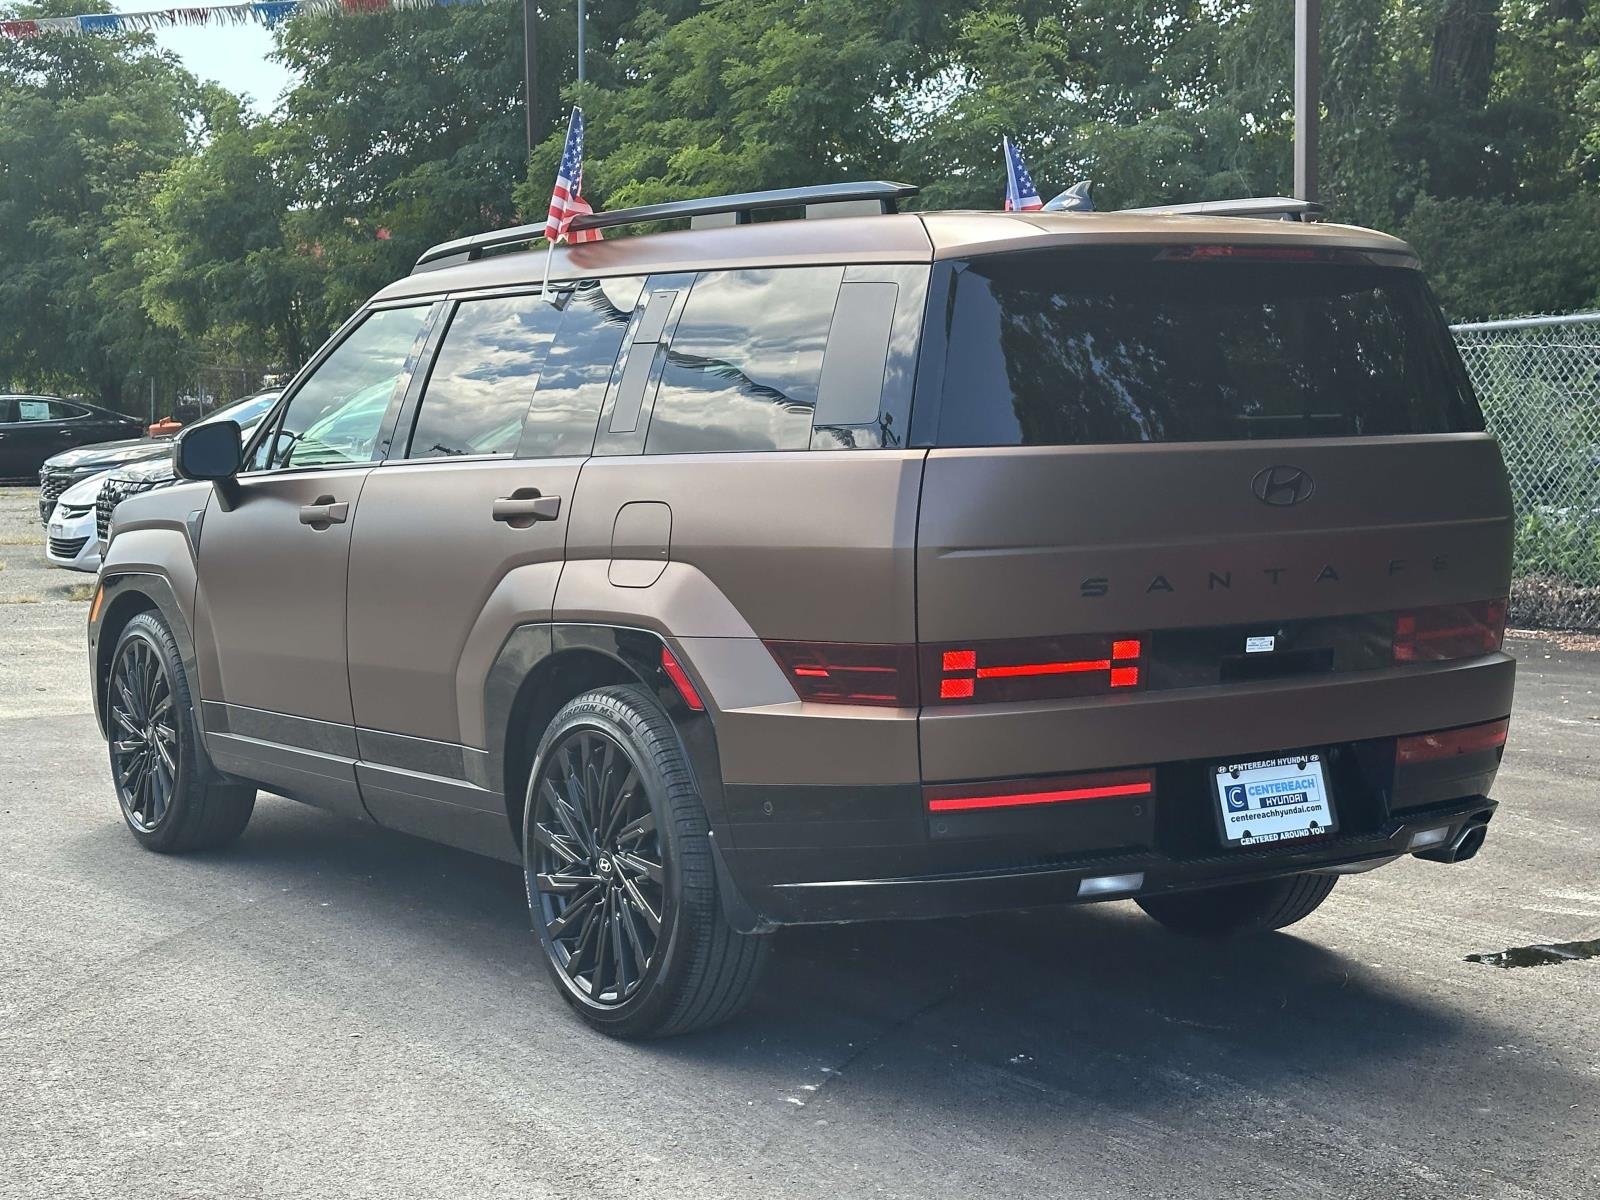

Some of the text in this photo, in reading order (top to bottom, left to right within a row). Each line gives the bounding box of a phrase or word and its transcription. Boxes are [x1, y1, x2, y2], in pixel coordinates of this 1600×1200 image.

[1080, 554, 1450, 598] SANTA FE
[1228, 755, 1308, 773] CENTEREACH HYUNDAI
[1248, 778, 1316, 796] CENTEREACH
[1265, 793, 1304, 807] HYUNDAI
[1230, 804, 1322, 823] centereachhyundai.com
[1240, 826, 1325, 846] CENTERED AROUND YOU
